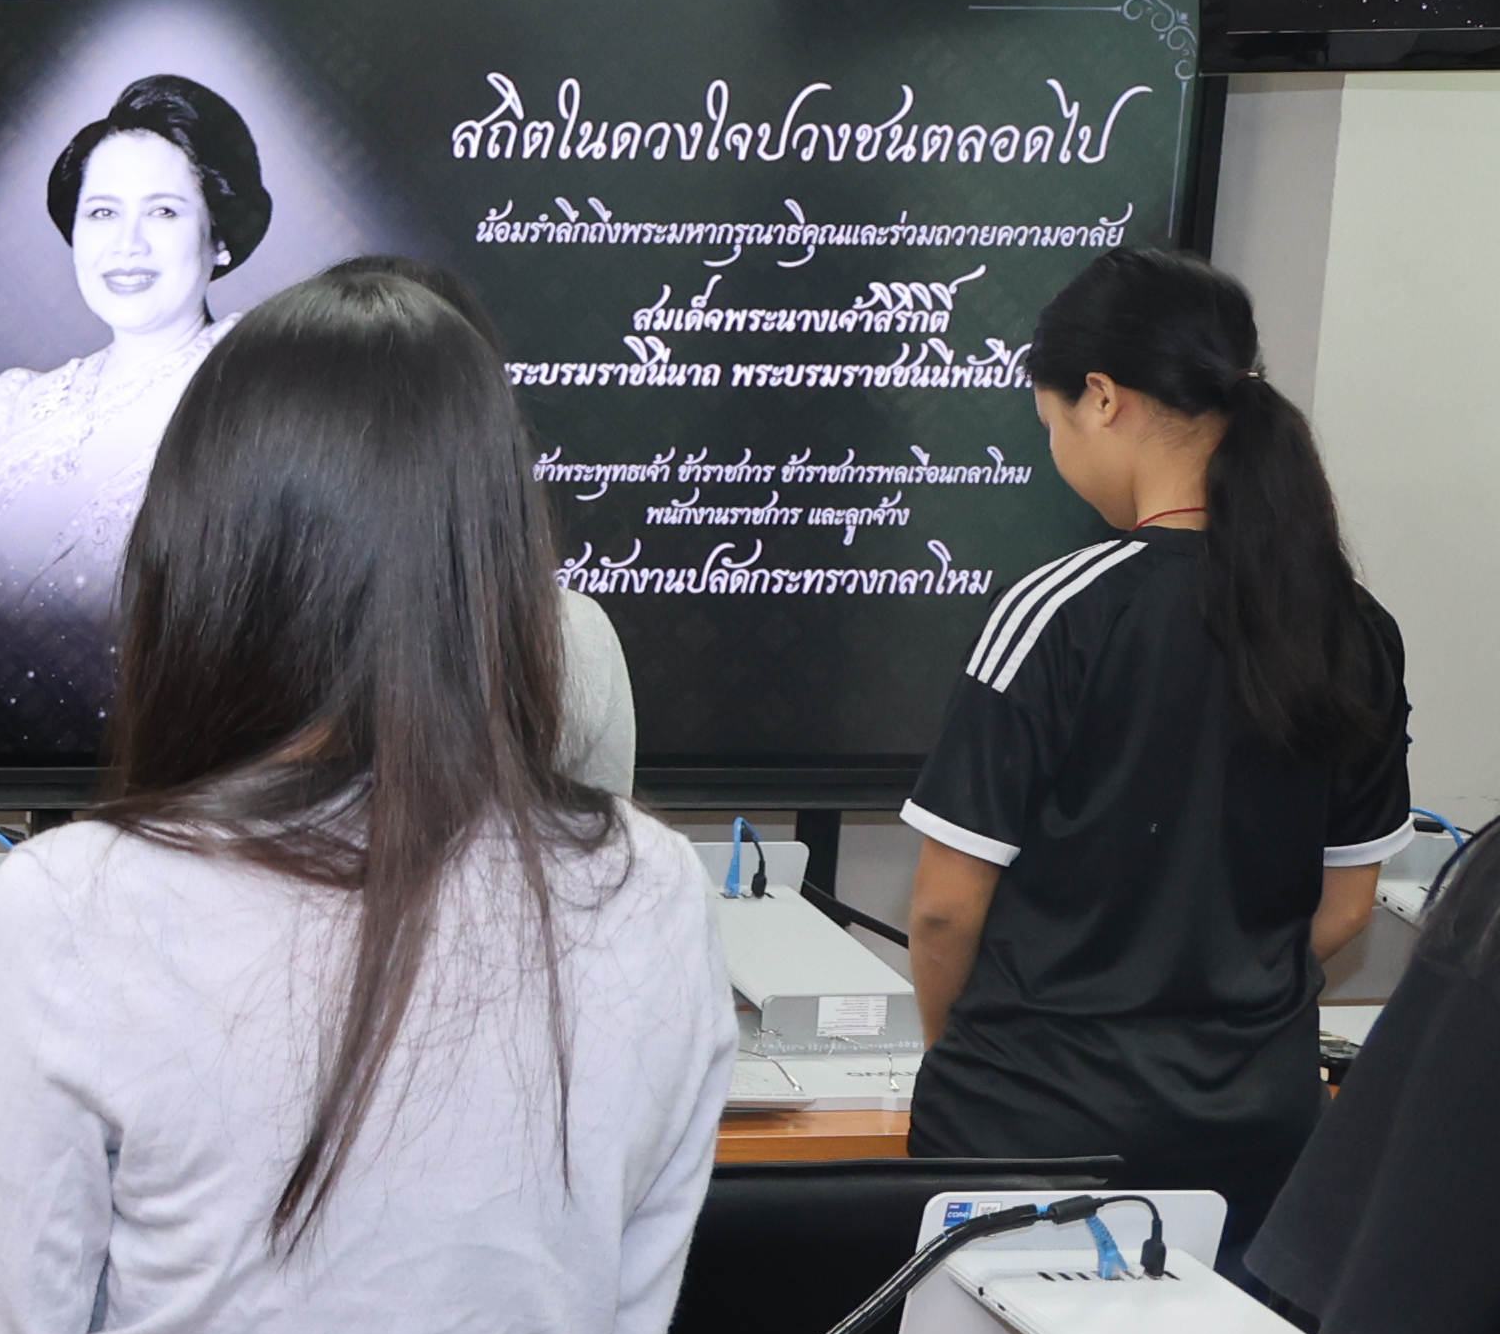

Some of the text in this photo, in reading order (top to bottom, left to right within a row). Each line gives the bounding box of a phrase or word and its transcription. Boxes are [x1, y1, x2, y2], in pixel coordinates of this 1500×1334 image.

[450, 71, 1153, 166] สถิตในดวงใจปวงชนตลอดไป
[632, 264, 987, 334] สมเด็จพระนางเจ้าสิริกิติ์
[677, 447, 776, 484] ข้าราชการ
[781, 445, 1031, 485] ข้าราชการพลเรือนกลาโหม
[646, 490, 910, 545] พนักงานราชการ และลูกจ้าง
